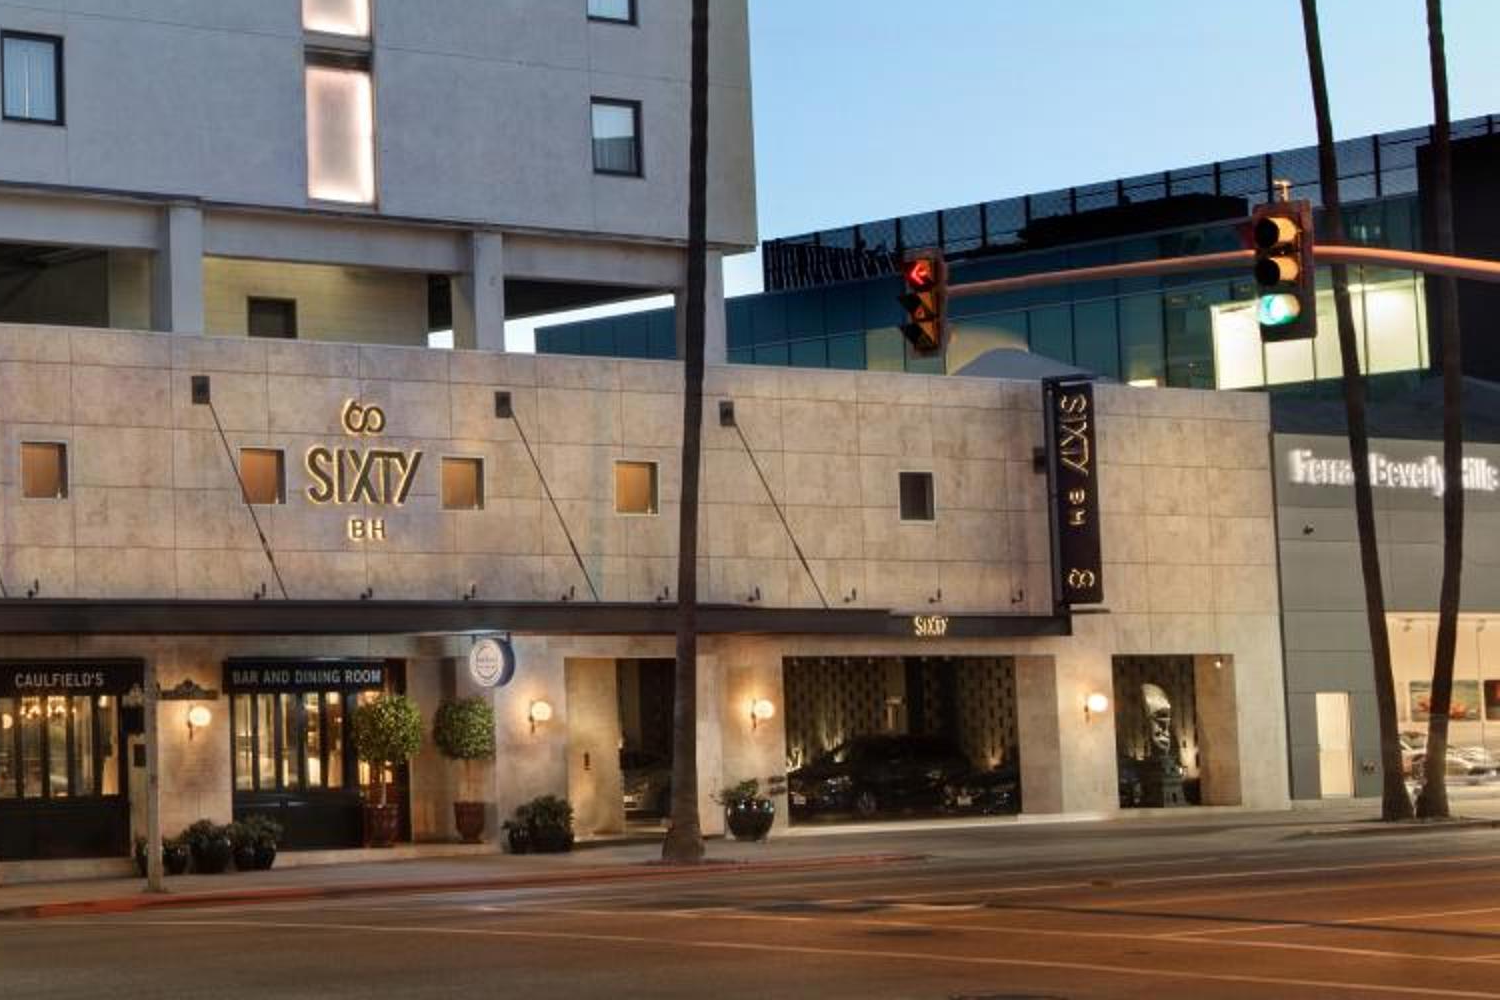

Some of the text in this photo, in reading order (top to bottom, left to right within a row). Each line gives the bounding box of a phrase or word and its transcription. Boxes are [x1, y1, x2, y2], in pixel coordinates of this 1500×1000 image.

[1060, 393, 1090, 475] SIXTY
[306, 445, 423, 505] SIXTY
[1368, 452, 1444, 497] Beverly
[348, 516, 386, 541] BH
[15, 673, 105, 688] CAULFIELD'S
[233, 669, 381, 684] BAR AND DINING ROOM
